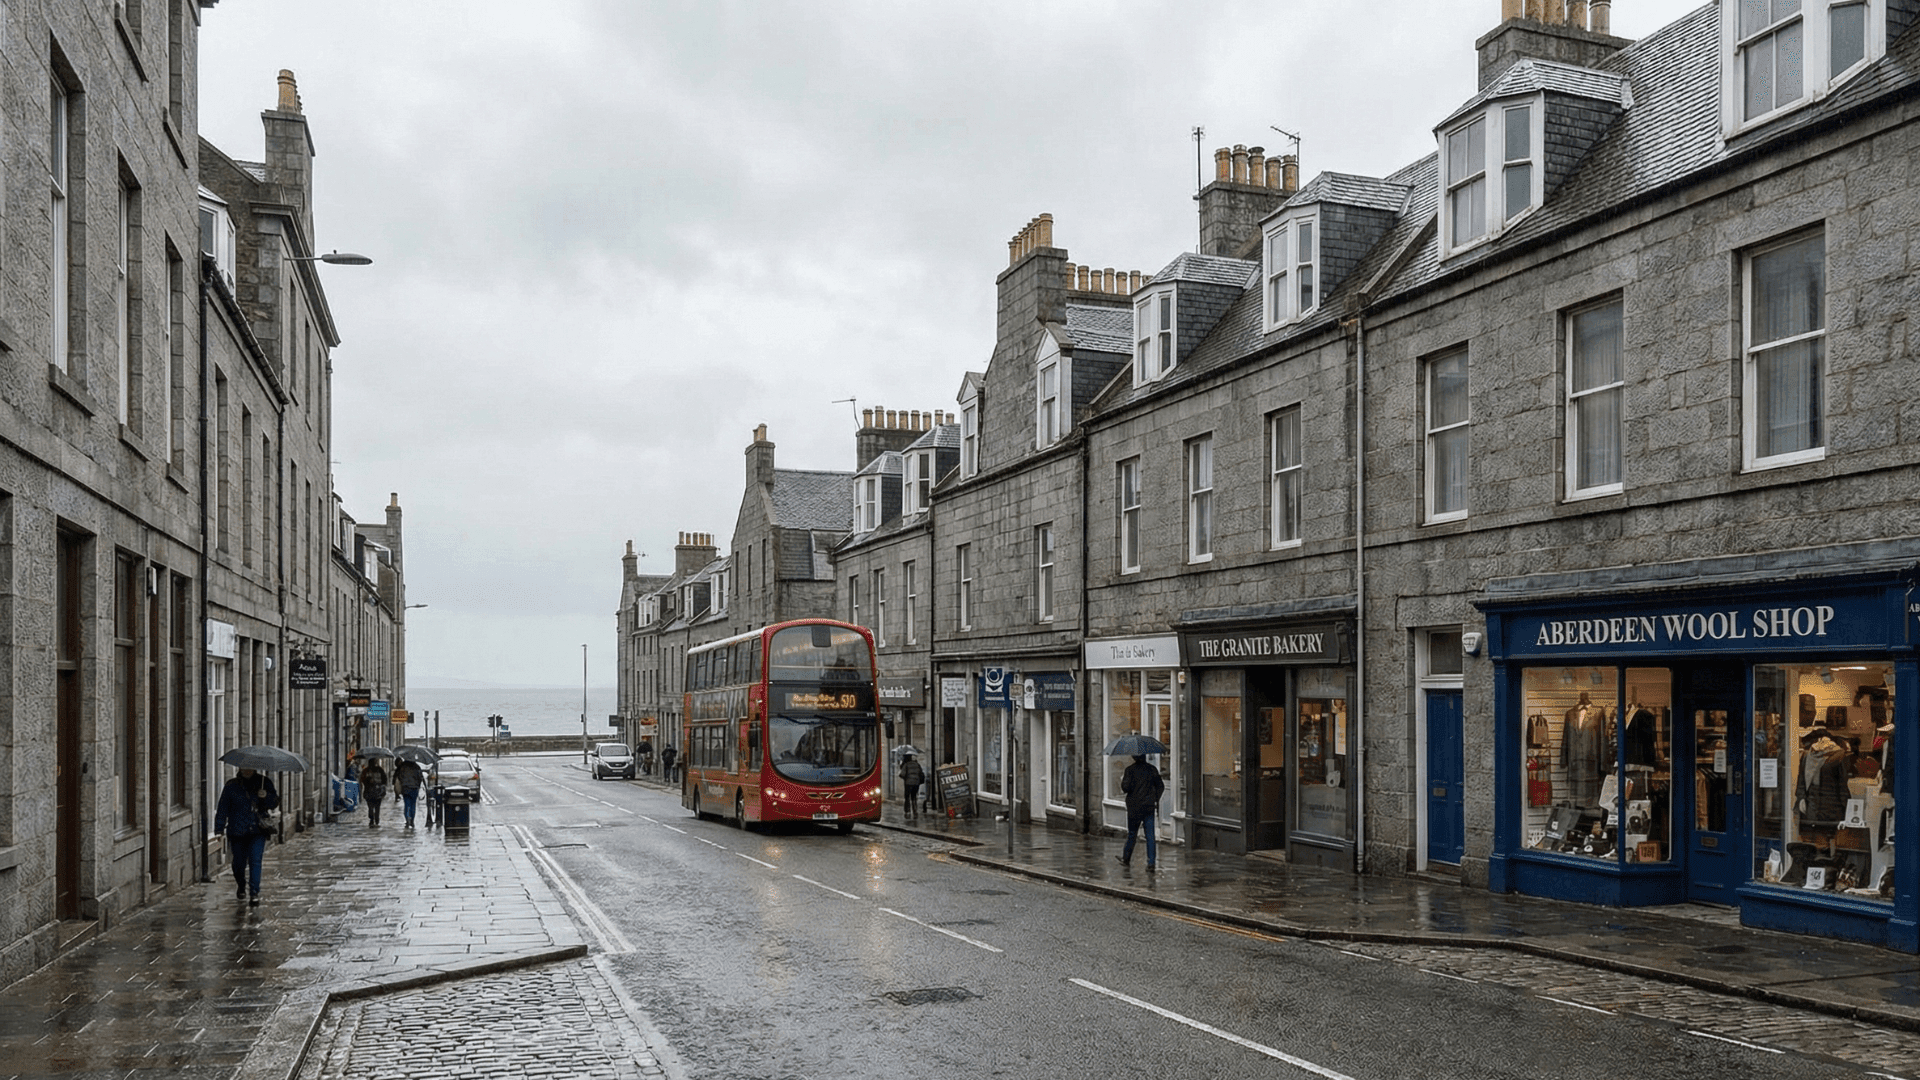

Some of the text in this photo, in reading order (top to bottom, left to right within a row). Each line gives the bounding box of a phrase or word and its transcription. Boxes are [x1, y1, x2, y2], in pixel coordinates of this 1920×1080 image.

[1536, 605, 1835, 646] ABERDEEN WOOL SHOP
[1199, 639, 1220, 658] THE
[1272, 632, 1324, 655] BAKERY
